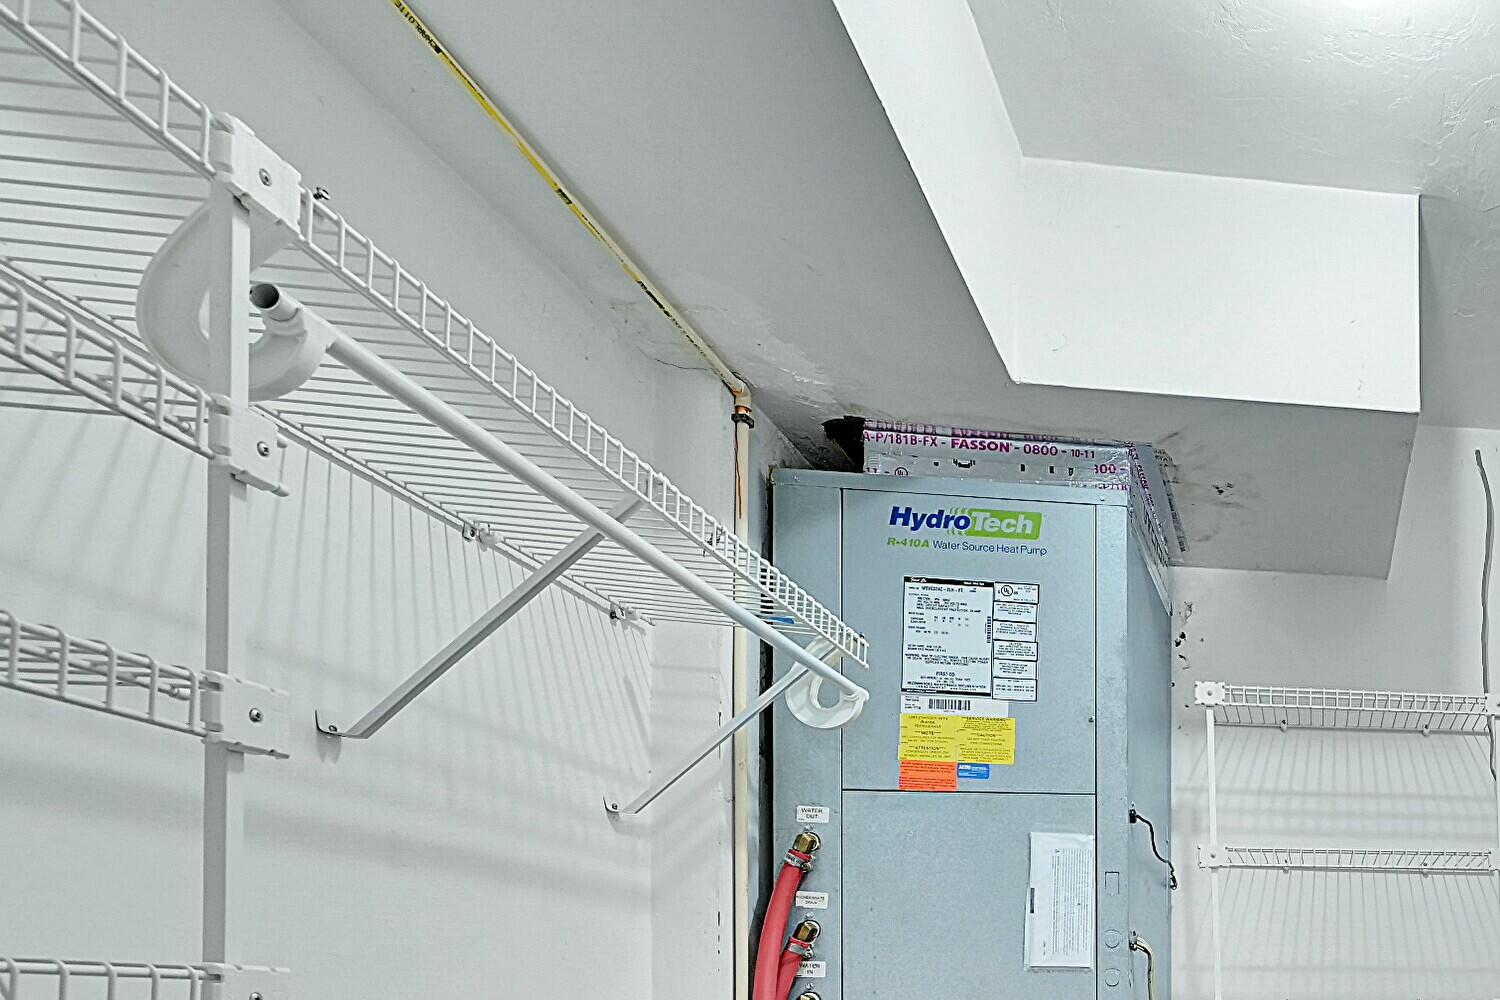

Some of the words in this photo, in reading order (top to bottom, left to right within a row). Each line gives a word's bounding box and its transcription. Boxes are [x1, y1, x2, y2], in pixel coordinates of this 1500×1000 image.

[1023, 443, 1059, 456] 0800
[1071, 449, 1095, 459] 10-11
[887, 537, 930, 548] R-410A
[932, 540, 962, 551] Water
[962, 541, 995, 553] Source
[996, 543, 1019, 554] Heat
[1020, 545, 1048, 557] Pump
